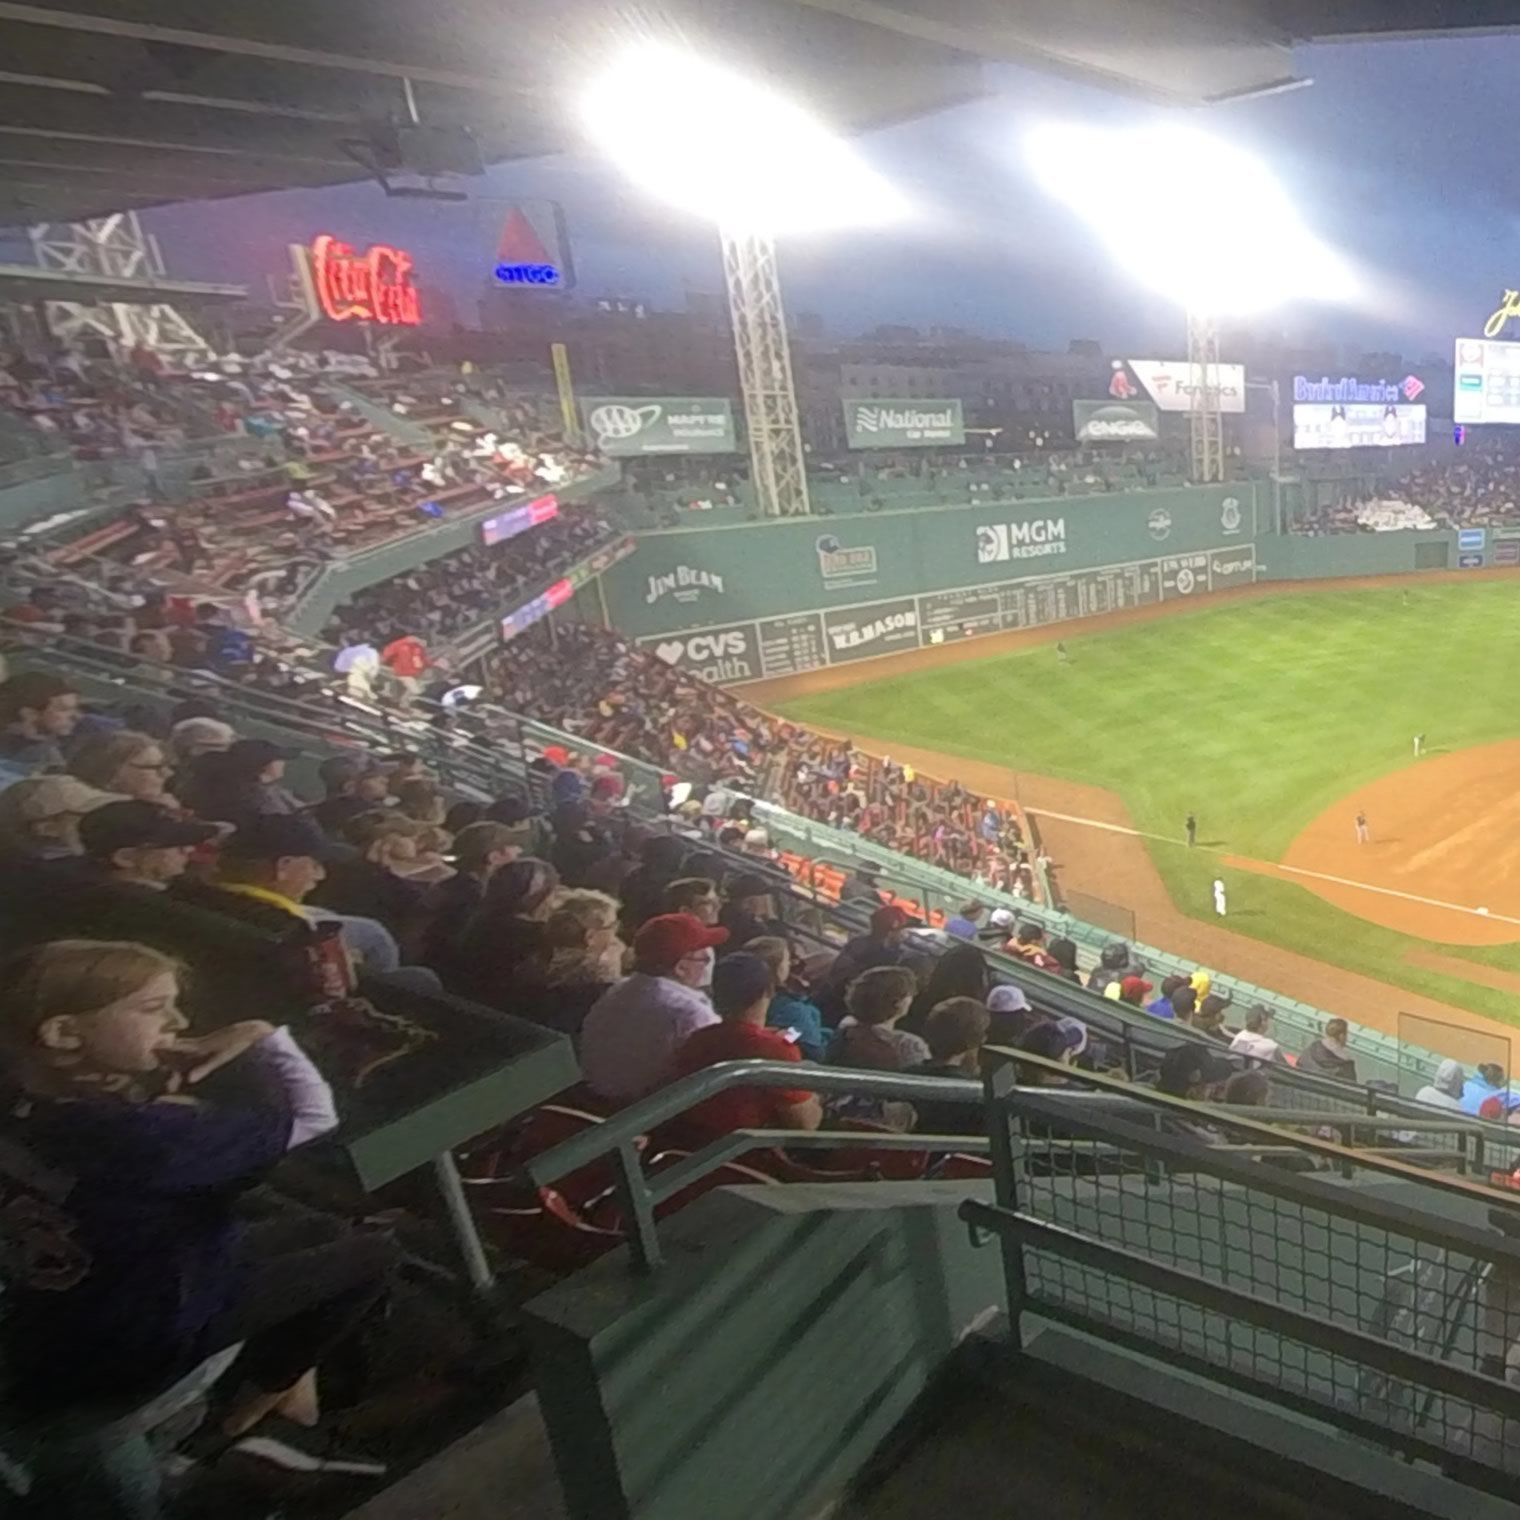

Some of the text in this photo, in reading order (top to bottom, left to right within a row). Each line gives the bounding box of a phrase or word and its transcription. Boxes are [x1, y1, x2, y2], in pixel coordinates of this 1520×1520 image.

[879, 408, 955, 429] National
[1010, 518, 1066, 545] MGM
[686, 631, 747, 661] CVS
